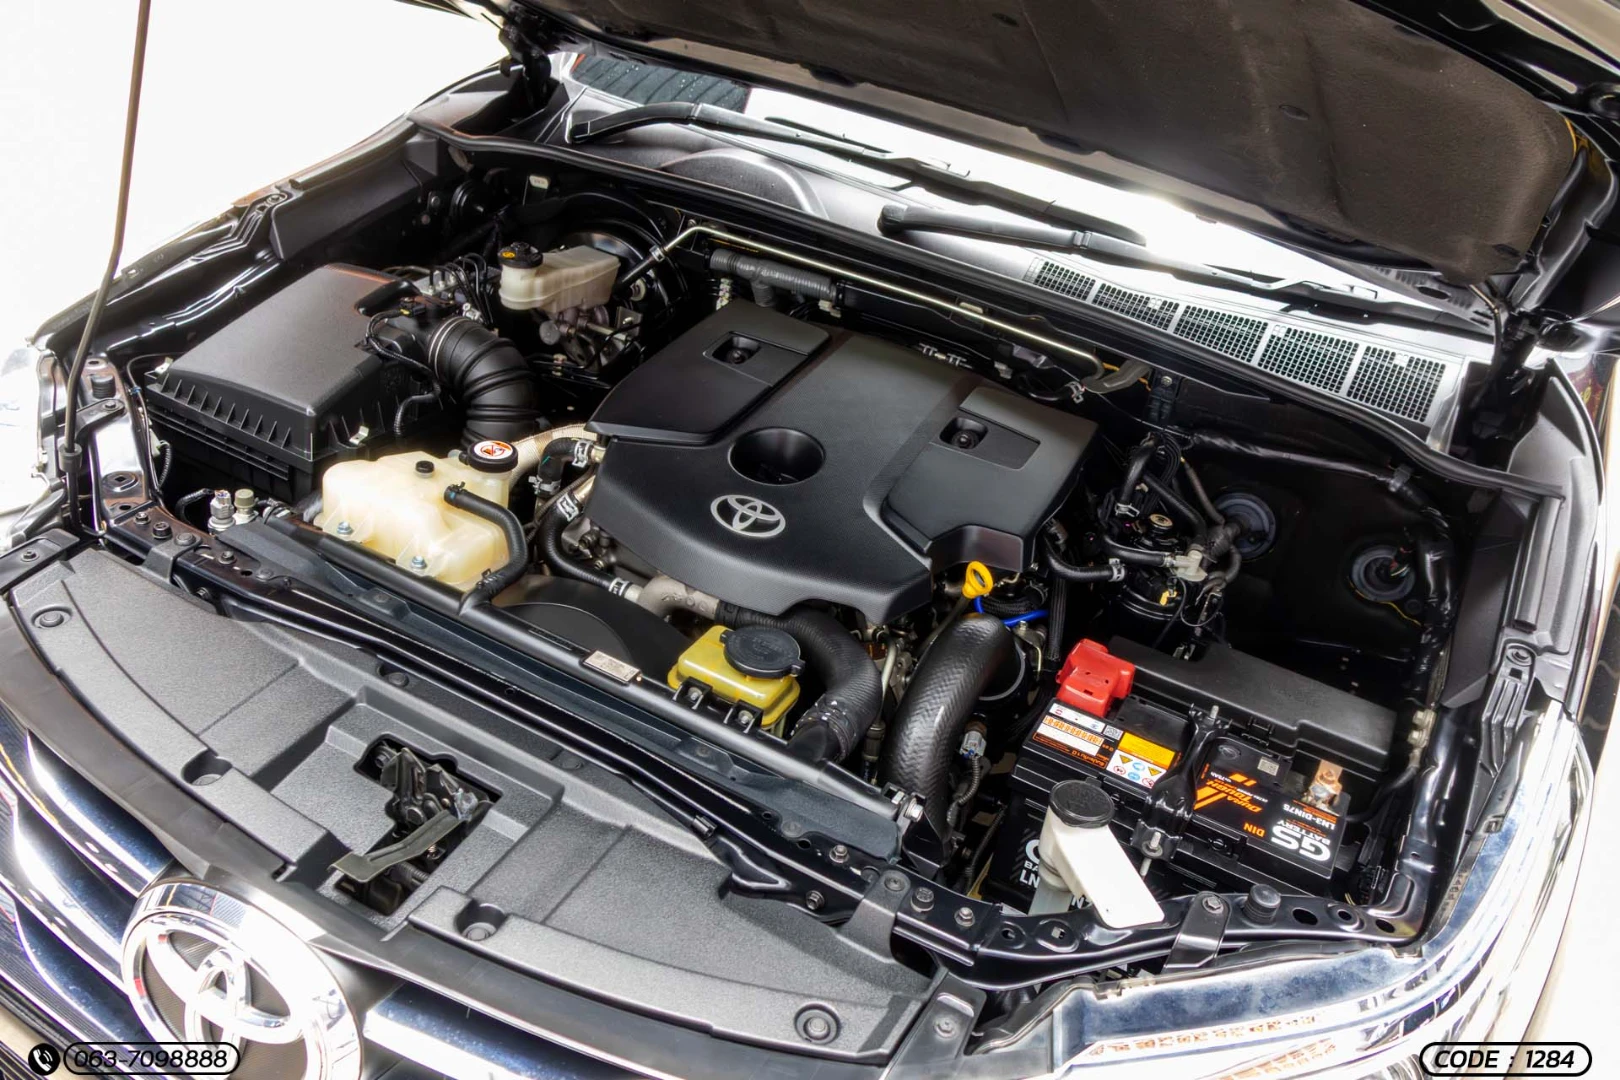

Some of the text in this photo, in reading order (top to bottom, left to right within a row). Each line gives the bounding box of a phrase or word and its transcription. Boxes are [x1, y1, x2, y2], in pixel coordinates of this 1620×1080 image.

[1243, 822, 1265, 838] DIN
[1282, 803, 1336, 831] LN3-DIN75
[1270, 824, 1331, 862] GS
[1277, 820, 1331, 846] BATTERY
